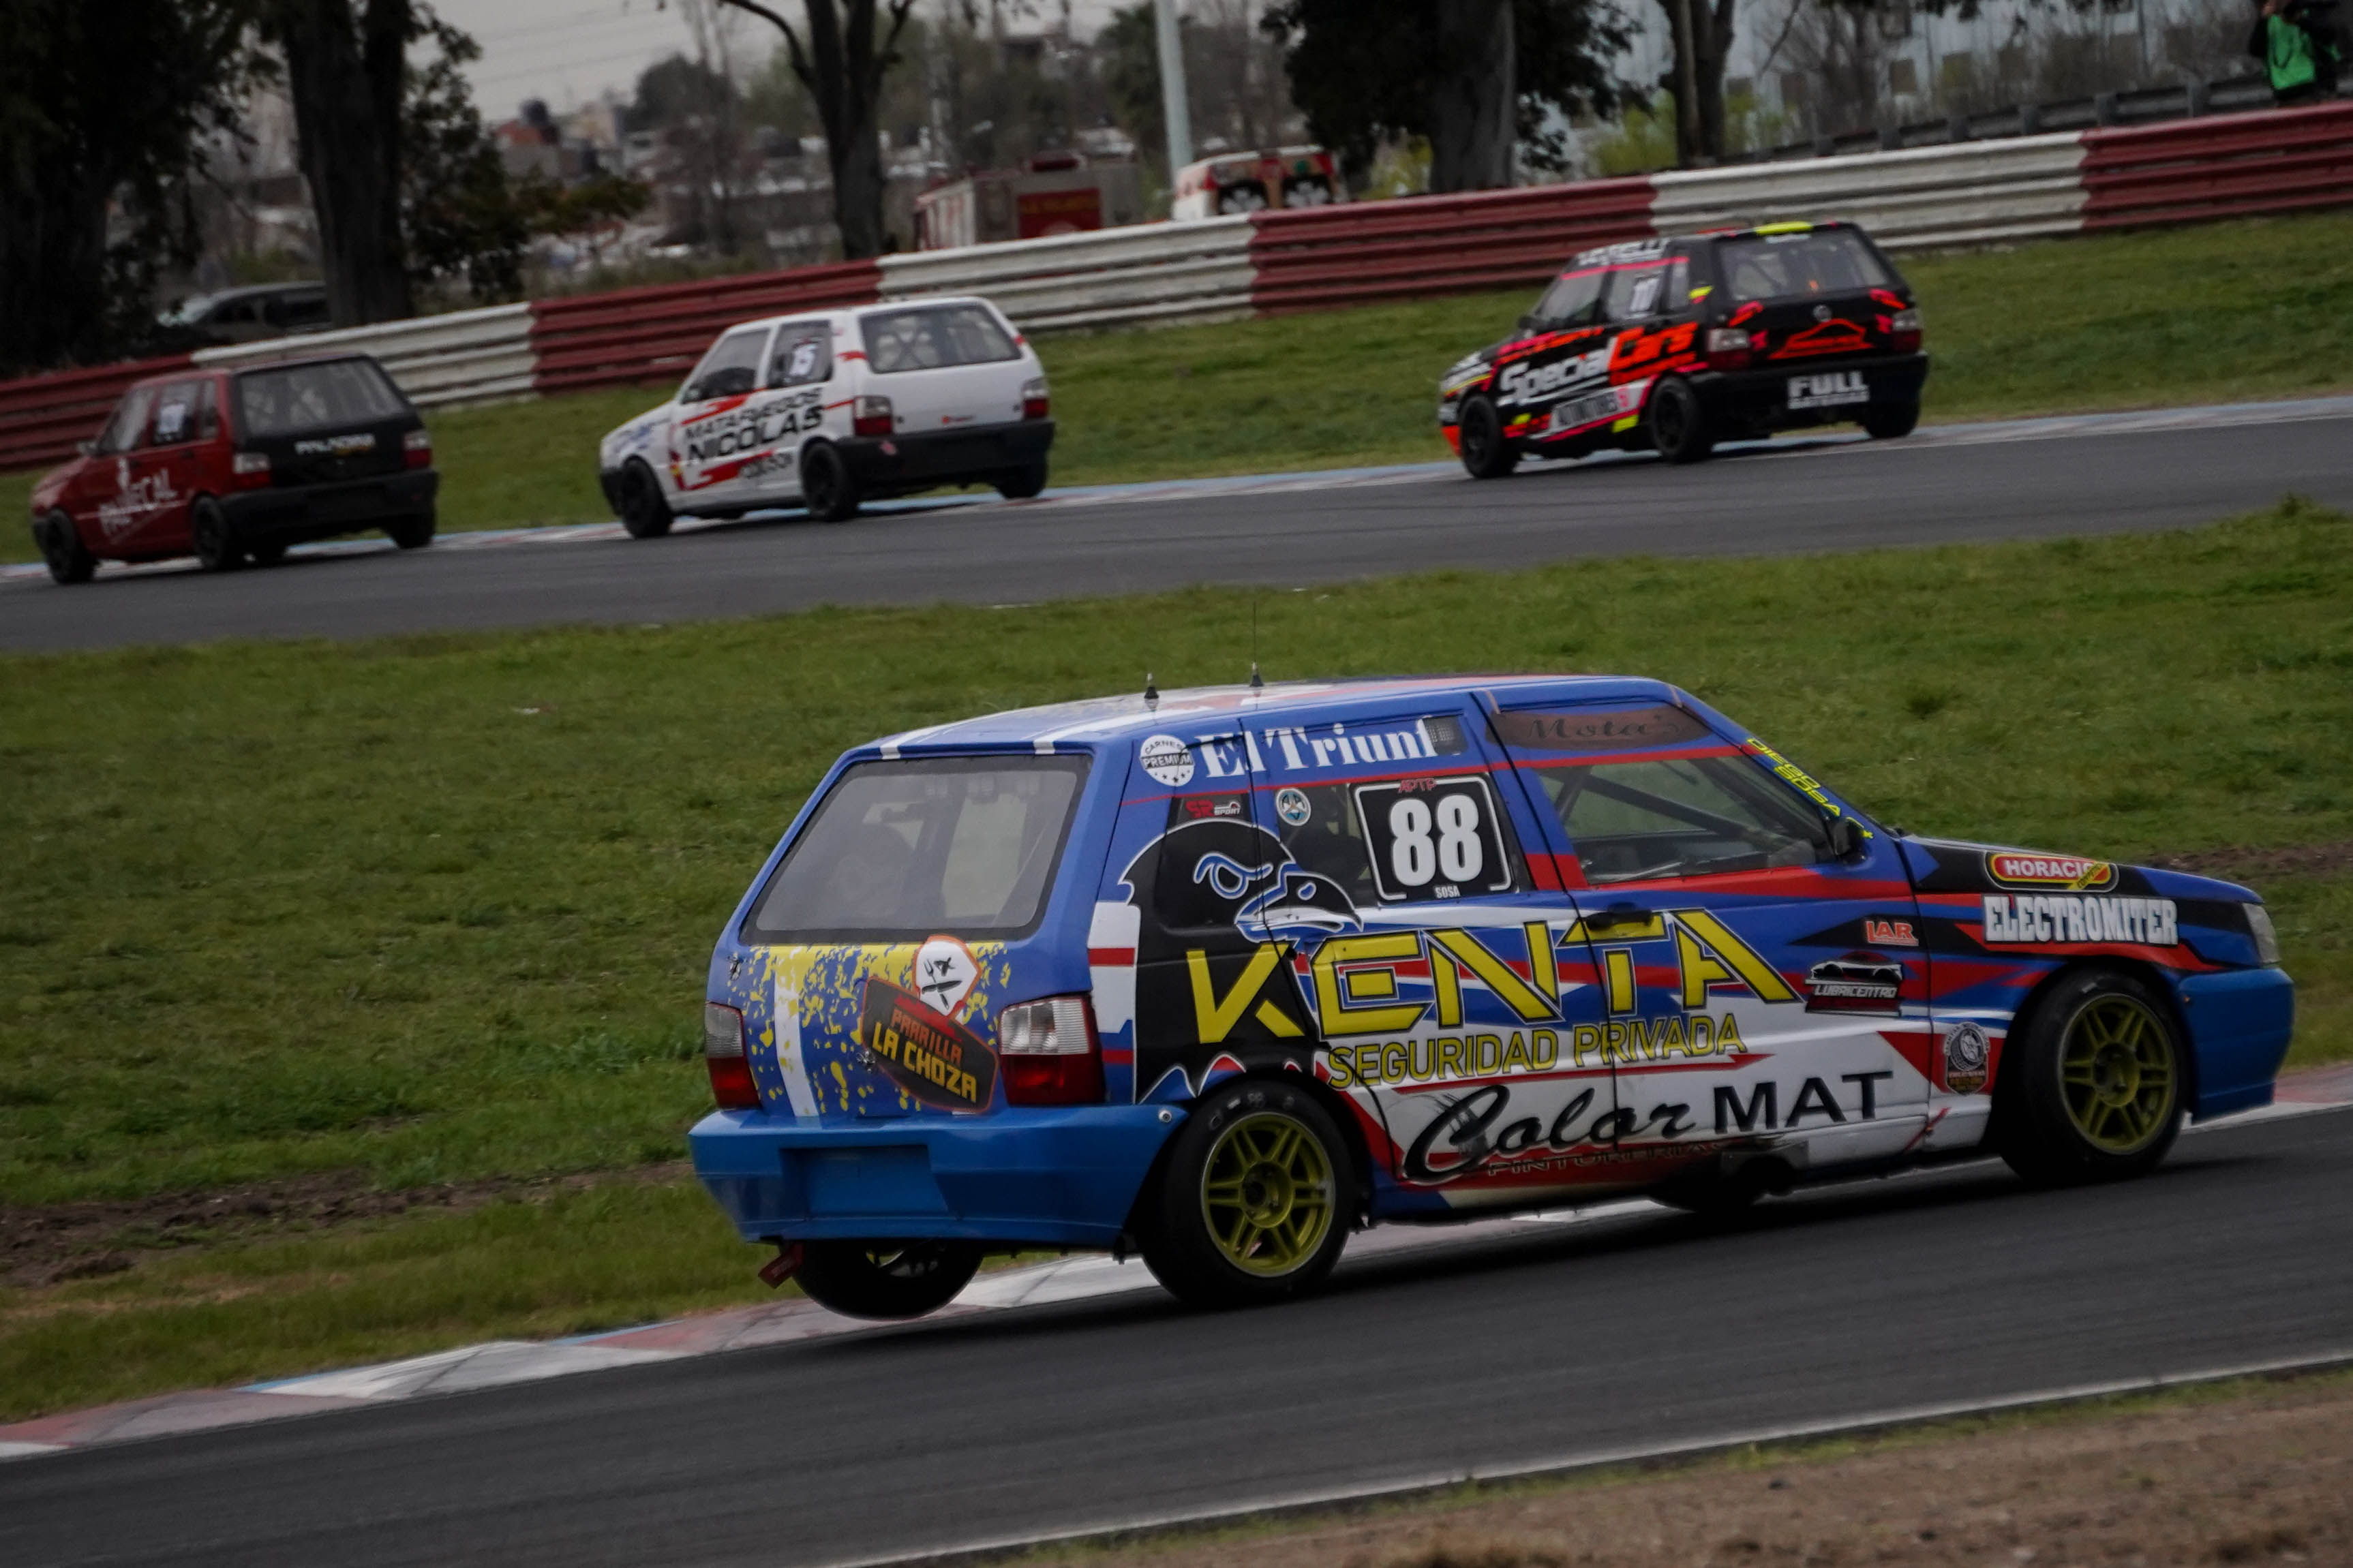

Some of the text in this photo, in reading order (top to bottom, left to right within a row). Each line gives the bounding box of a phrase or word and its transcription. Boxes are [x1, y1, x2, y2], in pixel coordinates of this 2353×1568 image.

[1788, 371, 1869, 397] FULL
[688, 405, 823, 460] NICOLAS
[1142, 754, 1193, 769] PREMIUM
[1145, 740, 1183, 754] CARNES
[1195, 716, 1461, 778] El Triunf
[1746, 738, 1821, 788] DIEGO
[1185, 799, 1240, 818] SR SPORT
[1774, 766, 1841, 817] SOSA
[1389, 793, 1483, 887] 88
[1435, 885, 1461, 899] SOSA
[1866, 921, 1915, 942] LAR
[1984, 895, 2179, 945] ELECTROMITER
[1186, 907, 1805, 1044] KENTA
[1814, 985, 1898, 999] LUBRICENTRO
[872, 1021, 978, 1103] LA CHOZA
[890, 1008, 962, 1066] PARRILLA
[1327, 1013, 1748, 1089] SEGURIDAD PRIVADA
[1714, 1070, 1894, 1134] MAT
